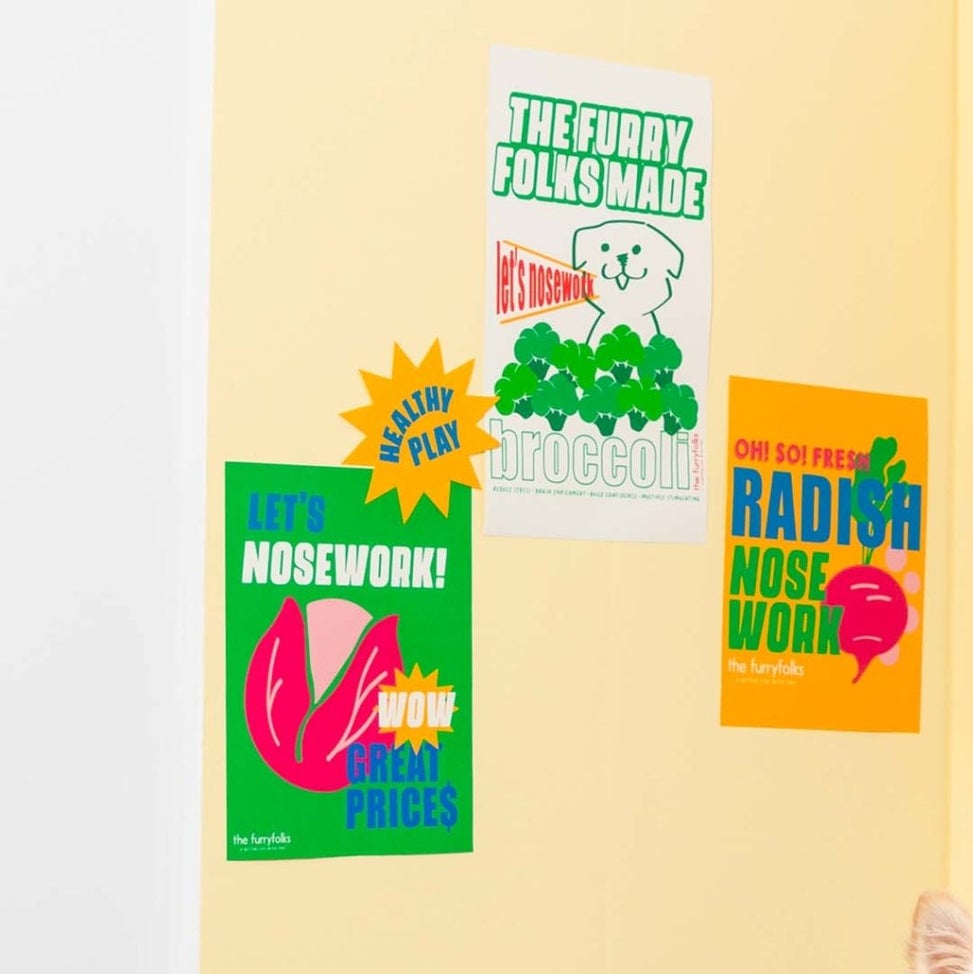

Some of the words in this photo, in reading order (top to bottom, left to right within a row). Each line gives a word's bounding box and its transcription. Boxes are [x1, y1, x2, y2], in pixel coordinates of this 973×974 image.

[510, 91, 577, 151] THE
[577, 102, 693, 166] FURRY
[492, 142, 604, 207] FOLKS
[605, 158, 707, 220] MADE
[496, 240, 525, 315] let's
[528, 262, 594, 309] nosework
[379, 385, 454, 464] HEALTHY
[407, 419, 461, 467] PLAY
[489, 418, 691, 491] broccoli
[735, 438, 769, 462] OH!
[775, 442, 807, 466] SO!
[812, 447, 871, 472] FRESH
[248, 491, 325, 533] LET'S
[731, 467, 922, 552] RADISH
[241, 540, 447, 589] NOSEWORK!
[729, 545, 830, 602] NOSE
[727, 599, 845, 655] WORK
[728, 657, 747, 674] the
[750, 657, 805, 678] furryfolks
[378, 691, 457, 729] WOW
[347, 742, 443, 784] GREAT
[346, 781, 458, 832] PRICE$
[232, 833, 249, 846] the
[250, 831, 292, 847] furryfolks
